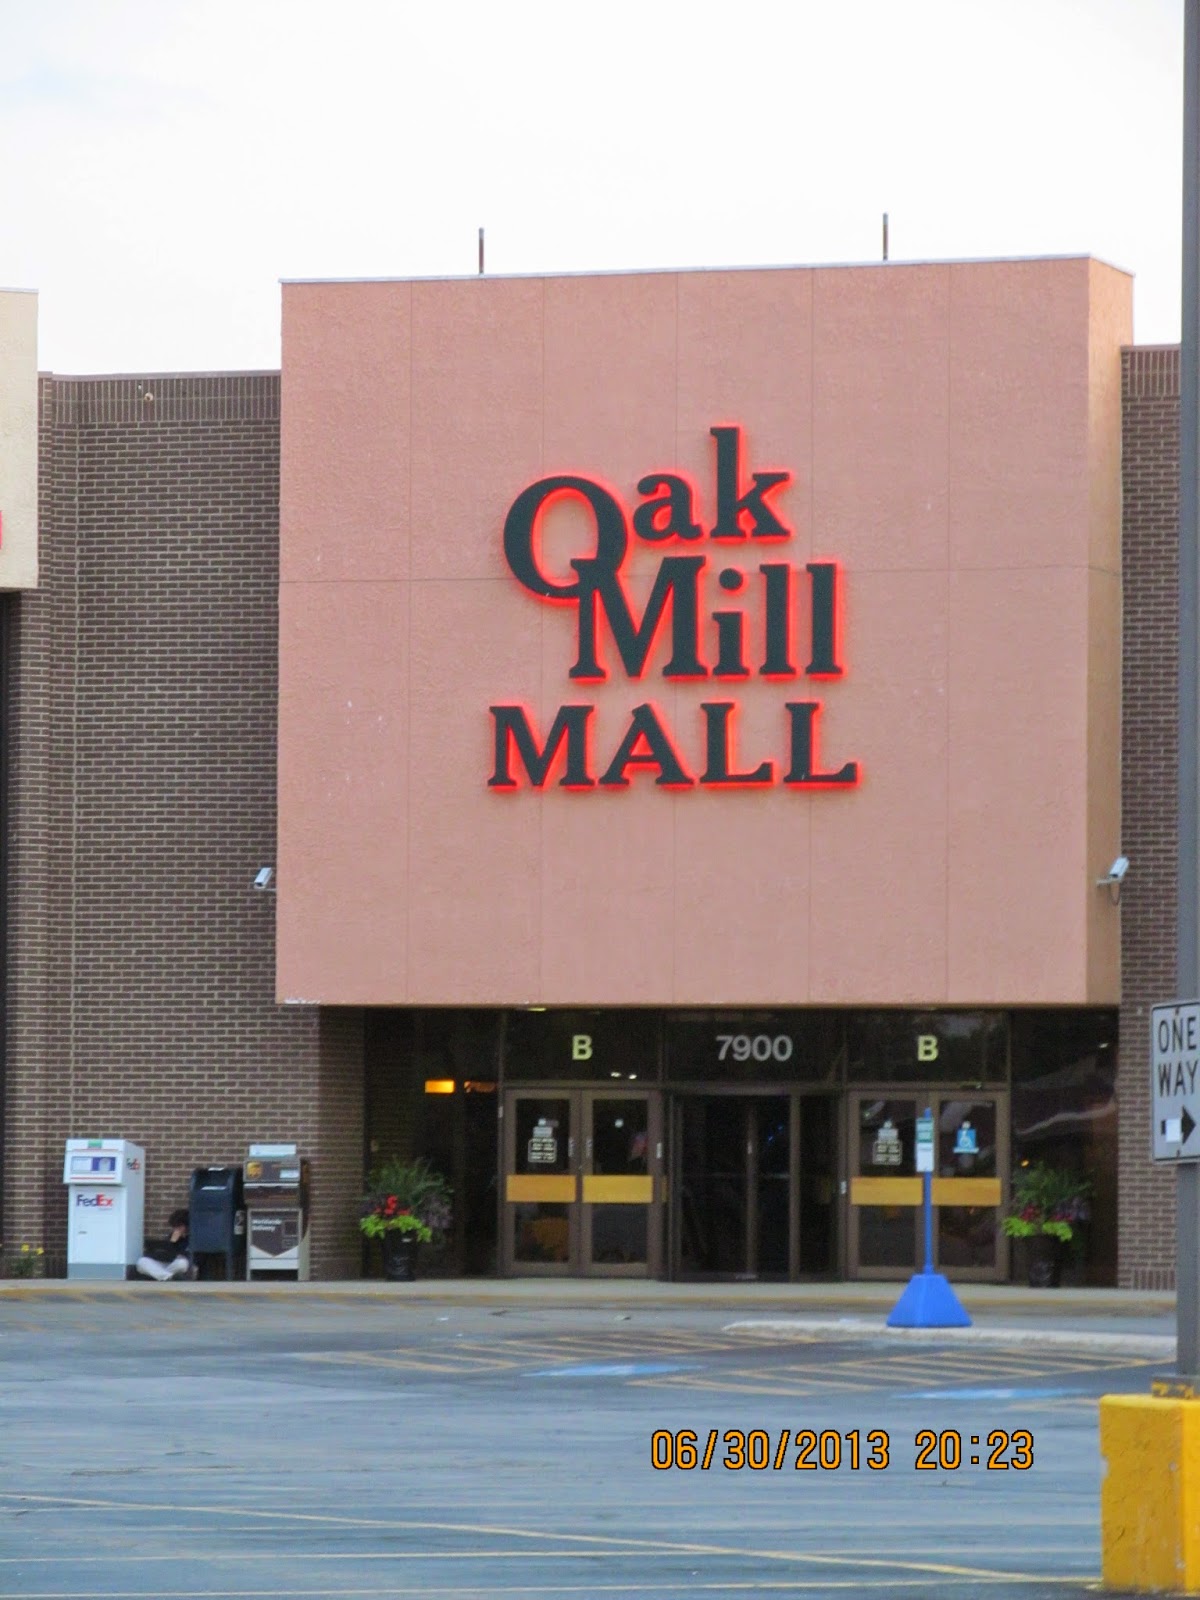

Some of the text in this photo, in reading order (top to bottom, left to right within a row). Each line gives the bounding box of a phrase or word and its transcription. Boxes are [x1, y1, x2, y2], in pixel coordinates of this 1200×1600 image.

[503, 426, 791, 599] Oak
[569, 555, 843, 679] Mill
[487, 702, 858, 786] MALL
[572, 1035, 593, 1060] B
[715, 1034, 793, 1062] 7900
[917, 1035, 939, 1061] B
[1158, 1016, 1197, 1053] ONE
[1158, 1060, 1198, 1098] WAY
[76, 1194, 113, 1208] FedEx
